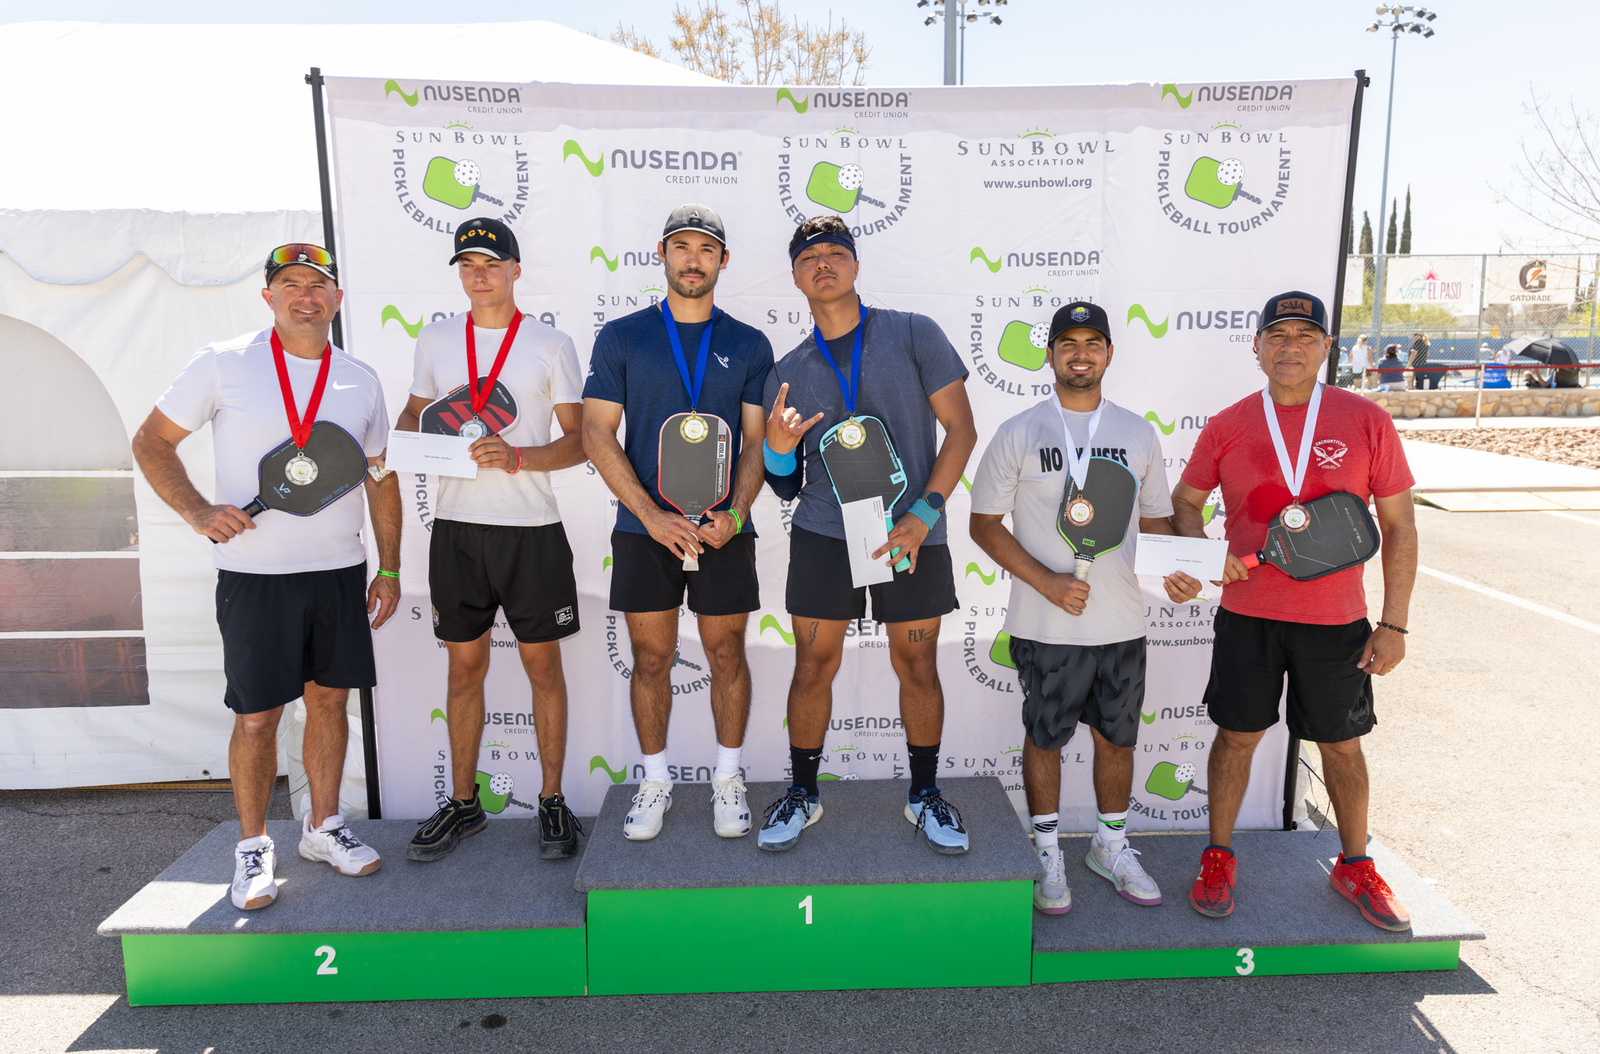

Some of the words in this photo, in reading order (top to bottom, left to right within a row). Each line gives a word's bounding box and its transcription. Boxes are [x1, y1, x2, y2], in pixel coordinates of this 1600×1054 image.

[423, 85, 521, 103] NUSENDA
[814, 92, 908, 108] NUSENDA
[1198, 84, 1292, 102] NUSENDA
[467, 106, 494, 114] CREDIT
[396, 130, 441, 143] SUN
[454, 131, 522, 145] BOWL
[783, 136, 828, 149] SUN
[840, 136, 907, 149] BOWL
[1164, 132, 1209, 145] SUN
[1221, 131, 1287, 143] BOWL
[957, 140, 1015, 156] SUN
[1031, 140, 1115, 156] BOWL
[611, 149, 737, 171] NUSENDA
[991, 158, 1084, 167] ASSOCIATION
[665, 175, 700, 184] CREDIT
[704, 176, 738, 184] UNION
[983, 177, 1092, 189] www.sunbowl.org
[393, 149, 455, 235] PICKLEBALL
[498, 150, 529, 225] NAMENT
[778, 154, 807, 226] PICKLEB
[850, 153, 912, 238] OURNAMENT
[1157, 150, 1212, 234] PICKLEBALL
[1218, 147, 1291, 235] TOURNAMENT
[460, 229, 497, 243] RGVR
[1007, 250, 1100, 267] NUSENDA
[1047, 269, 1073, 277] CREDIT
[1076, 268, 1100, 276] UNION
[1428, 282, 1438, 300] EL
[1440, 281, 1462, 300] PASO
[597, 294, 638, 307] SUN
[976, 295, 1020, 308] SUN
[1176, 310, 1260, 330] NUSEN
[1229, 334, 1254, 343] CRED
[971, 313, 1026, 396] PICKLEBALL
[1277, 534, 1293, 564] BANTAM
[1150, 620, 1211, 628] ASSOCIAT
[908, 628, 925, 643] FLY
[606, 615, 632, 679] PICKLEB
[963, 621, 1014, 693] PICKLEBALL
[1161, 705, 1210, 719] NUSE
[827, 716, 904, 731] USENDA
[491, 749, 540, 761] BOW
[841, 751, 901, 763] BOWL
[945, 756, 997, 769] SUN
[798, 895, 813, 925] 1
[314, 945, 338, 975] 2
[1234, 947, 1255, 976] 3
